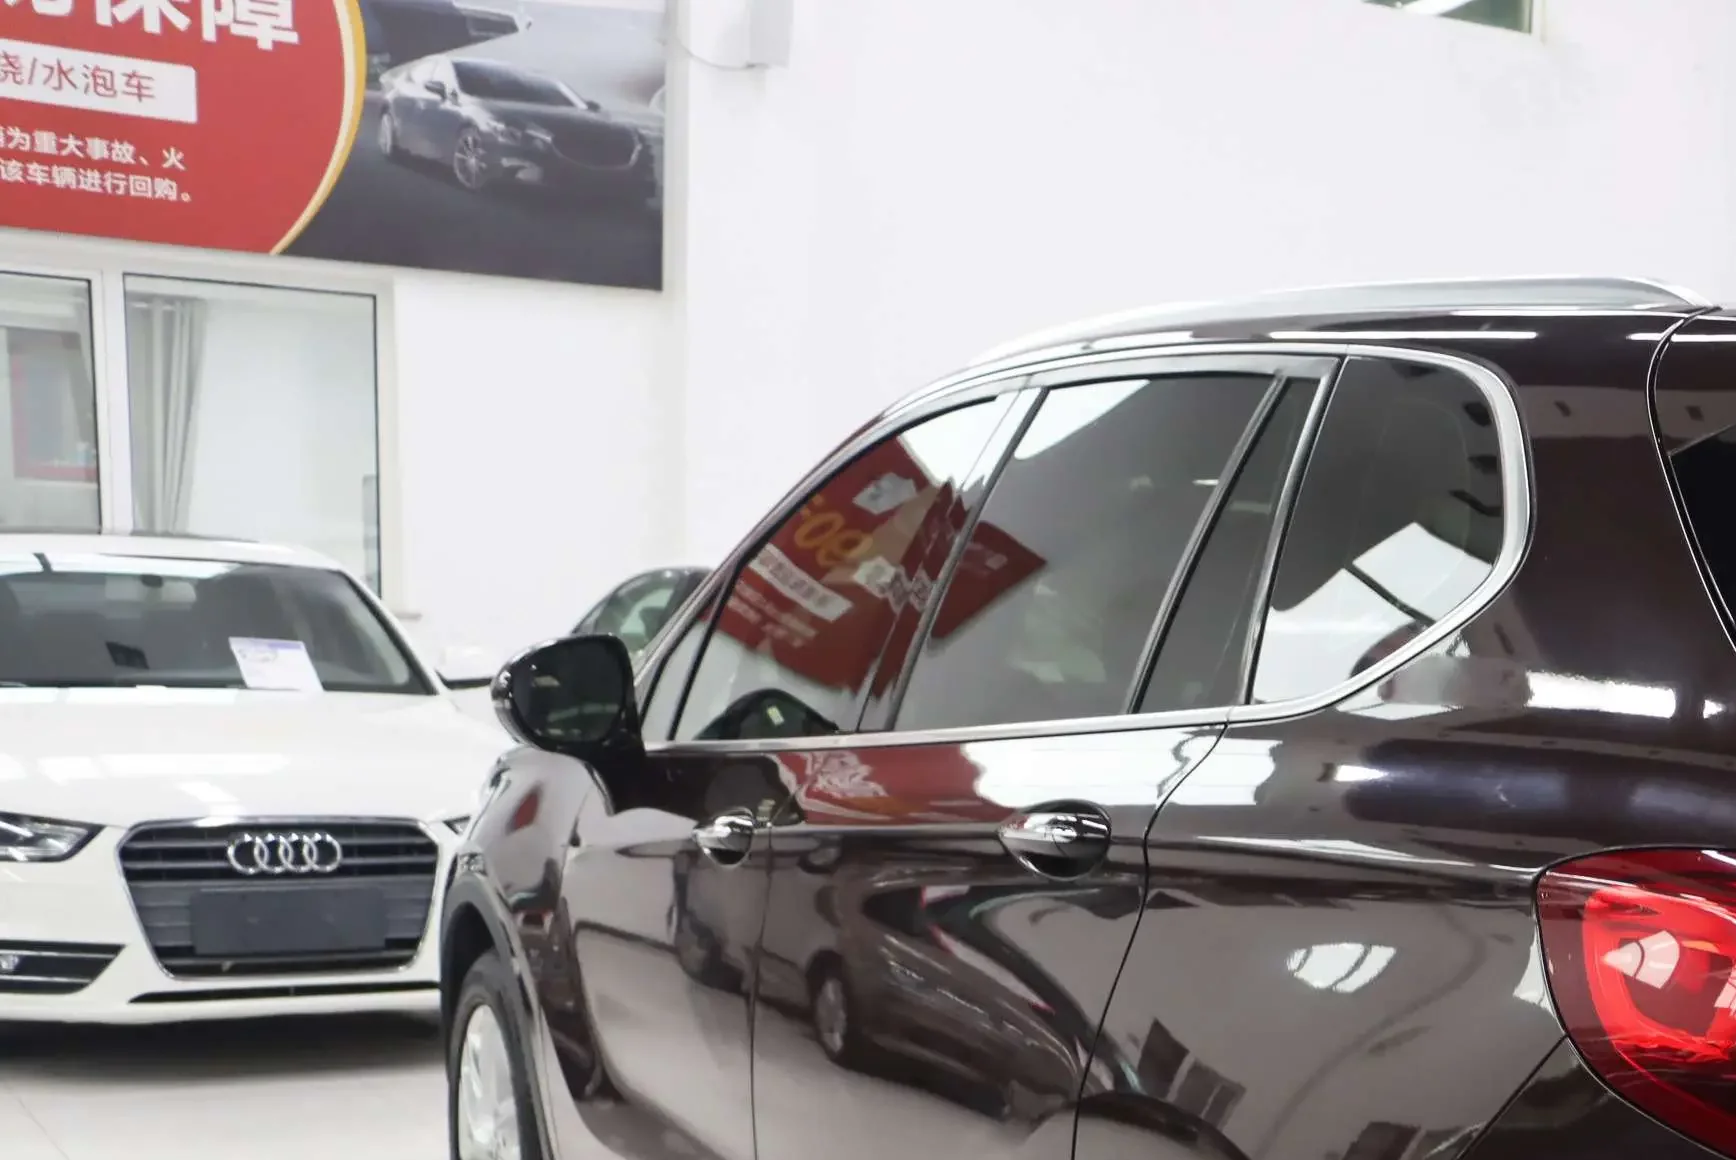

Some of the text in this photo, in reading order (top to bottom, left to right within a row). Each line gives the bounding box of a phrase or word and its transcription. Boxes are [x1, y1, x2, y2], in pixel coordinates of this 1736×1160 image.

[0, 126, 186, 171] 为重大事故、火
